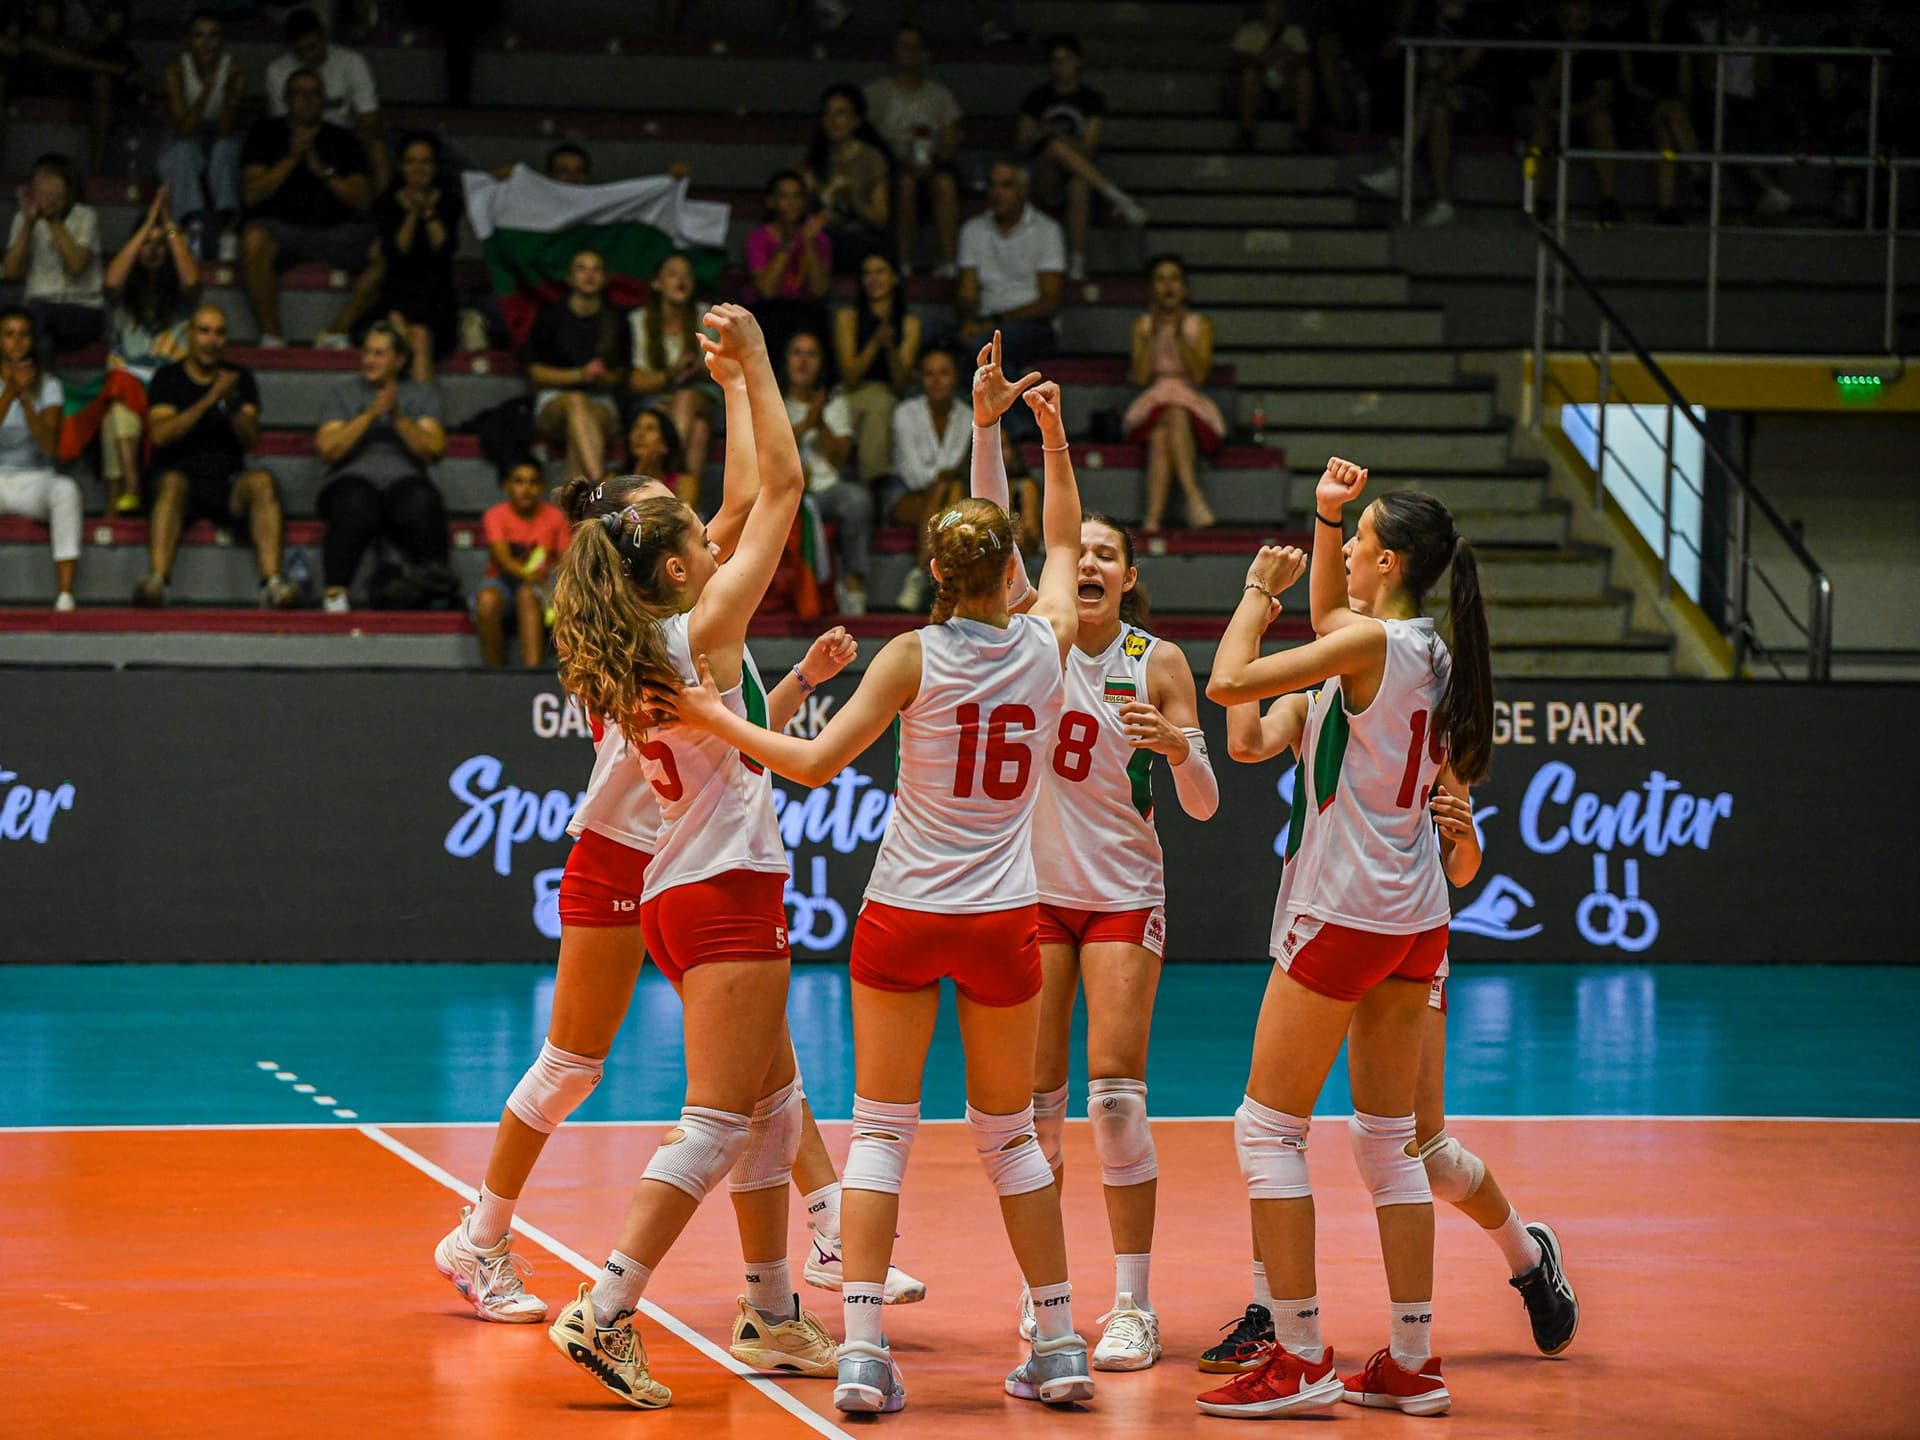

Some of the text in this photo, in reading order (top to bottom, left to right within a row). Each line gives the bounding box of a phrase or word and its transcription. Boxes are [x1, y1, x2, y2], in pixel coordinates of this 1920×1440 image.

[953, 703, 1035, 800] 16
[1052, 711, 1099, 782] 8
[1547, 701, 1646, 745] PARK
[1520, 761, 1733, 856] Center
[613, 900, 635, 912] 10
[775, 927, 786, 949] 5
